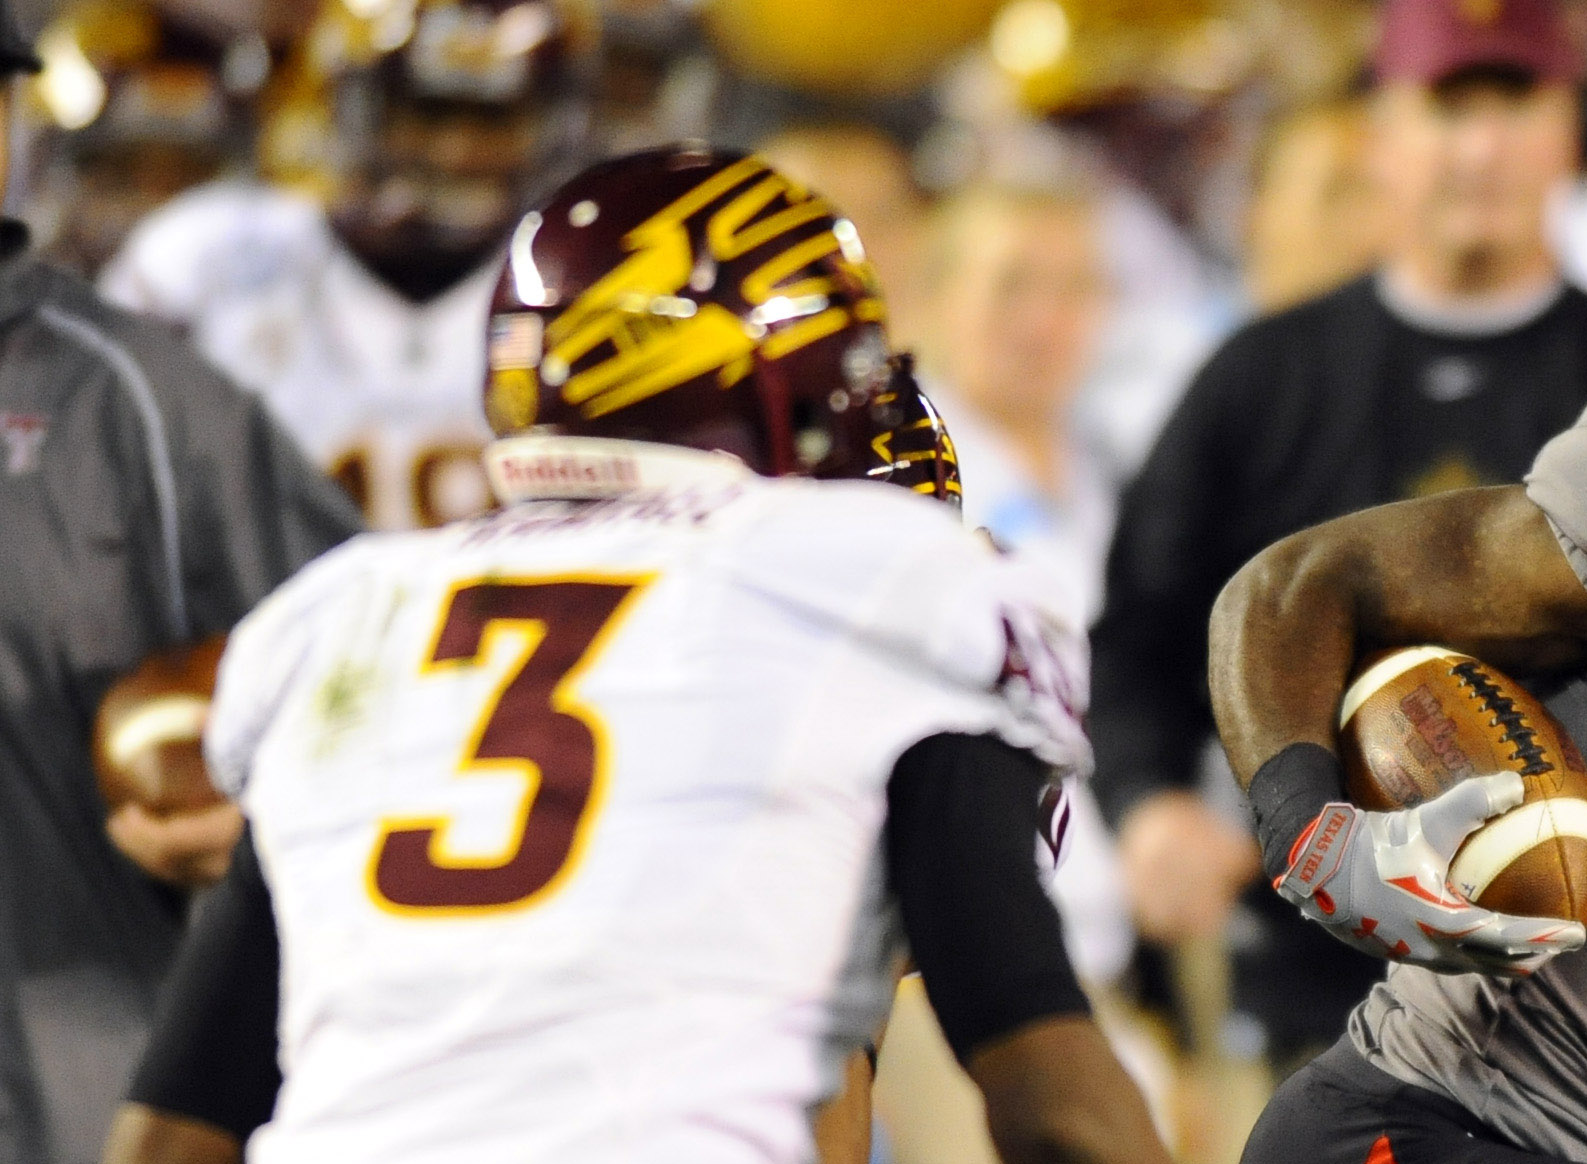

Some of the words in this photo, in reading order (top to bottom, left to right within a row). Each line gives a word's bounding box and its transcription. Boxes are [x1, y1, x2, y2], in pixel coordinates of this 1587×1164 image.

[362, 571, 662, 920] 3
[1314, 811, 1348, 853] TEXAS
[1298, 851, 1325, 885] TECH
